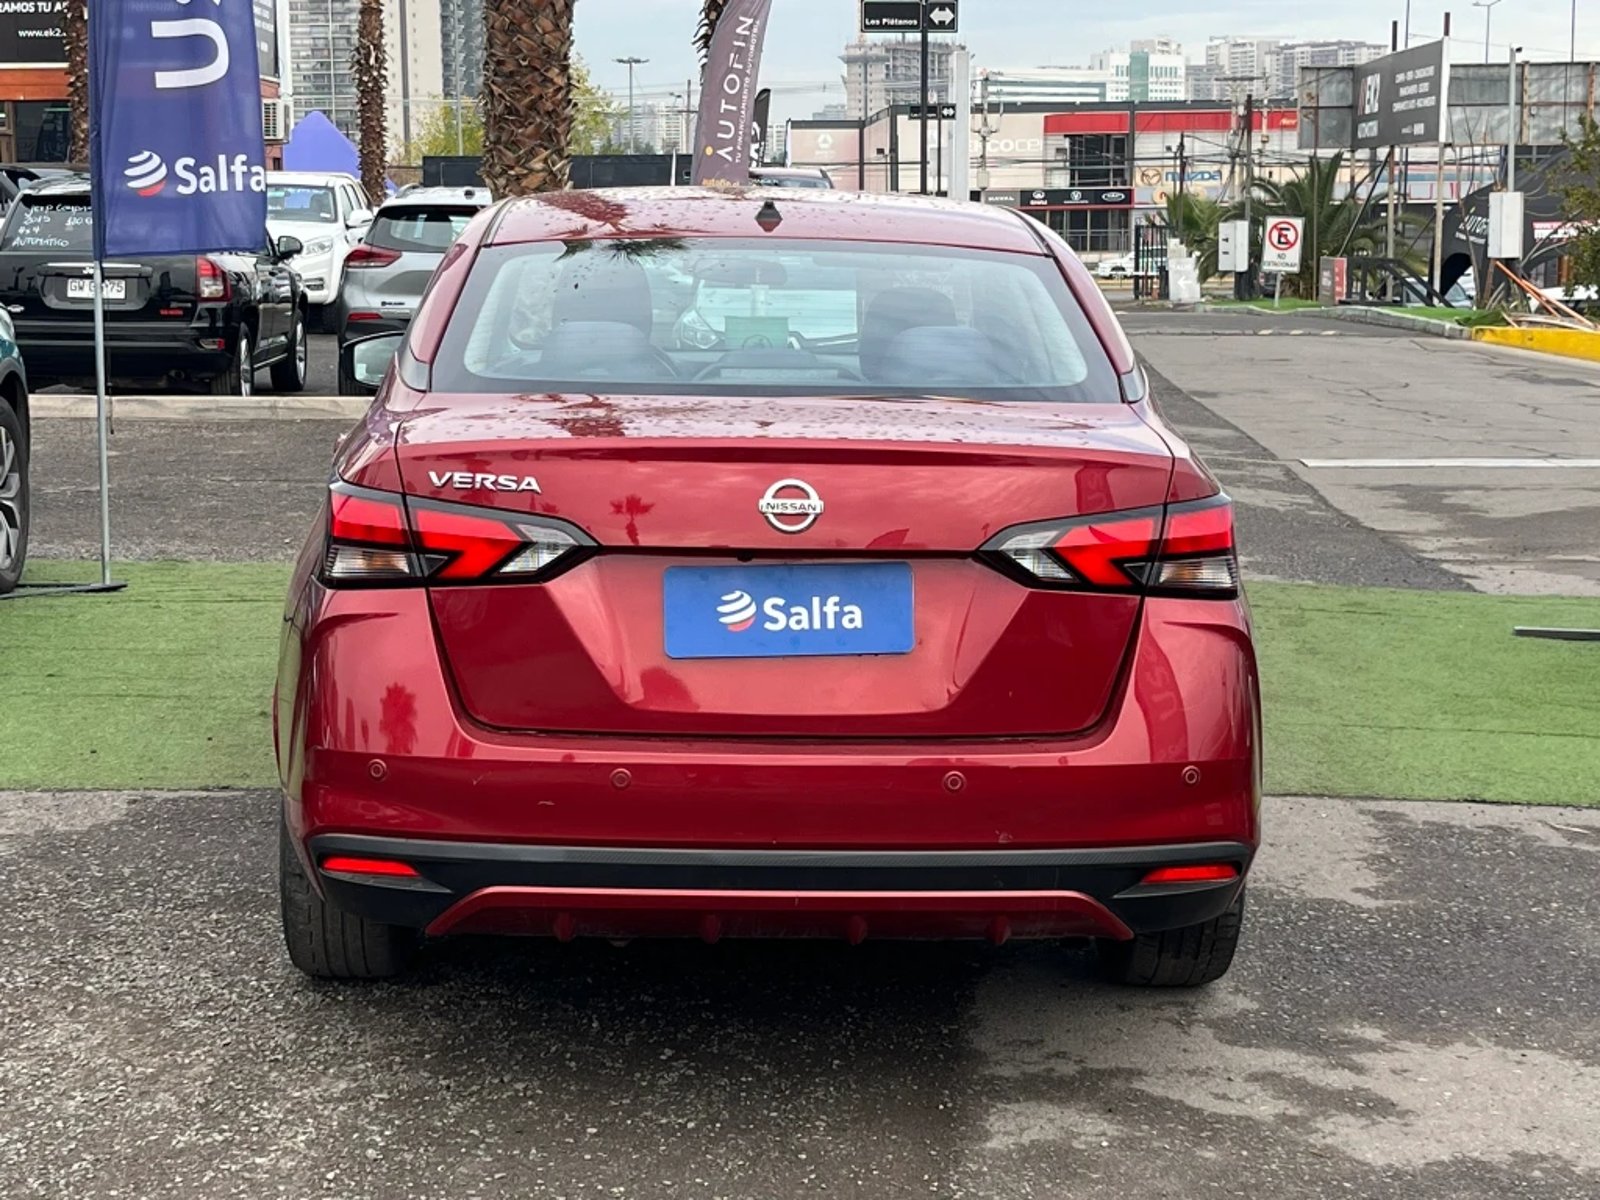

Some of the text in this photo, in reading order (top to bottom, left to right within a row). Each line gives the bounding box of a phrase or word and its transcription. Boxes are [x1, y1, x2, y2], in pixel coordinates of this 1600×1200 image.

[37, 2, 52, 13] TU
[716, 16, 754, 162] AUTOFIN
[174, 154, 265, 195] Salfa
[1278, 227, 1291, 245] E
[1277, 252, 1286, 260] NO
[428, 471, 541, 494] VERSA
[766, 502, 817, 512] NISSAN
[763, 597, 863, 631] Salfa
